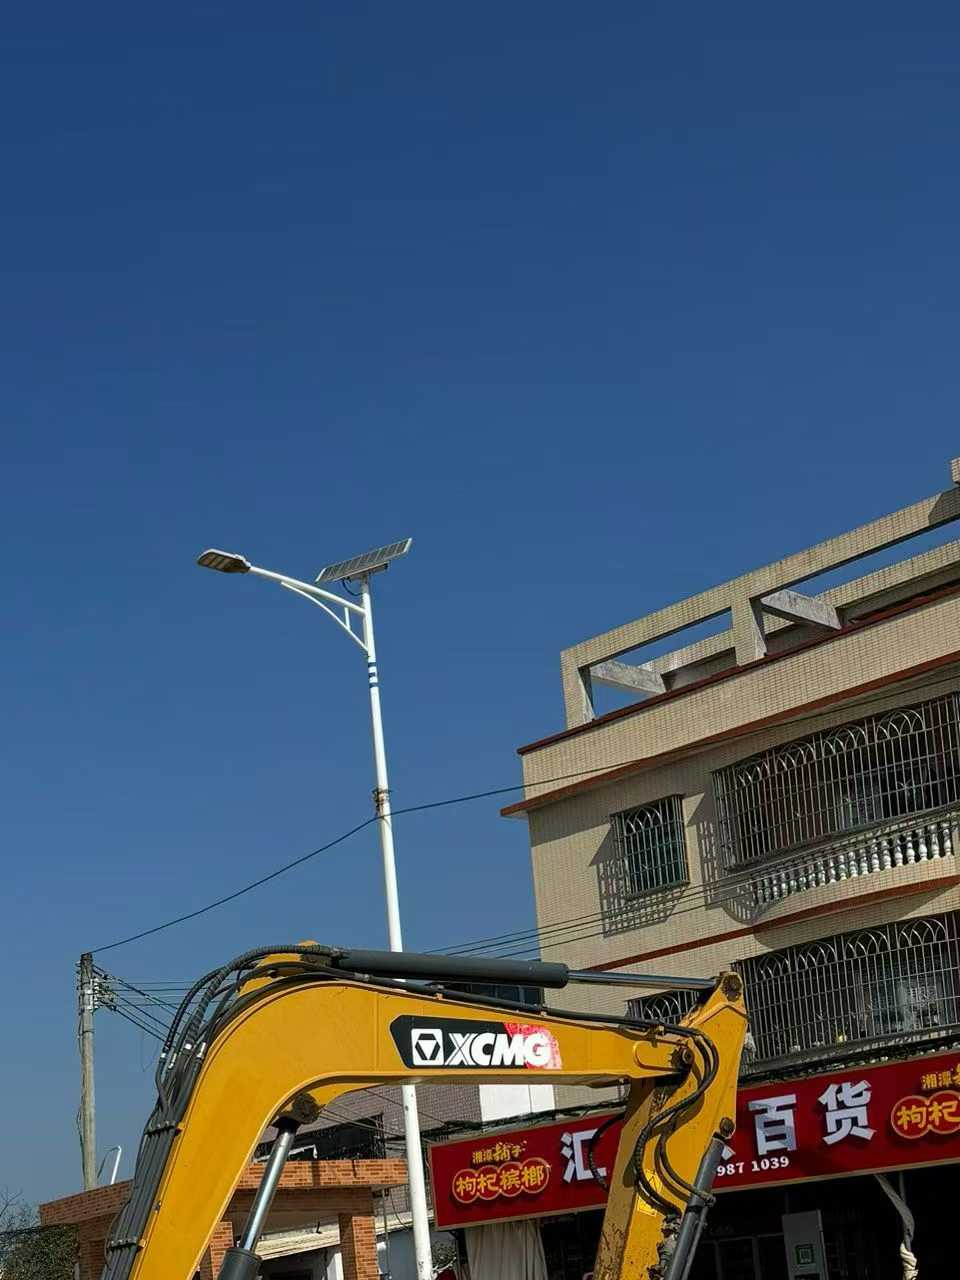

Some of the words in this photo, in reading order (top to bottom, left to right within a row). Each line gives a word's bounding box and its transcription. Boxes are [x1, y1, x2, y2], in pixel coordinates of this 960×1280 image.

[444, 1032, 551, 1067] XCMG
[455, 1164, 545, 1197] 枸杞槟榔
[751, 1156, 789, 1172] 1039
